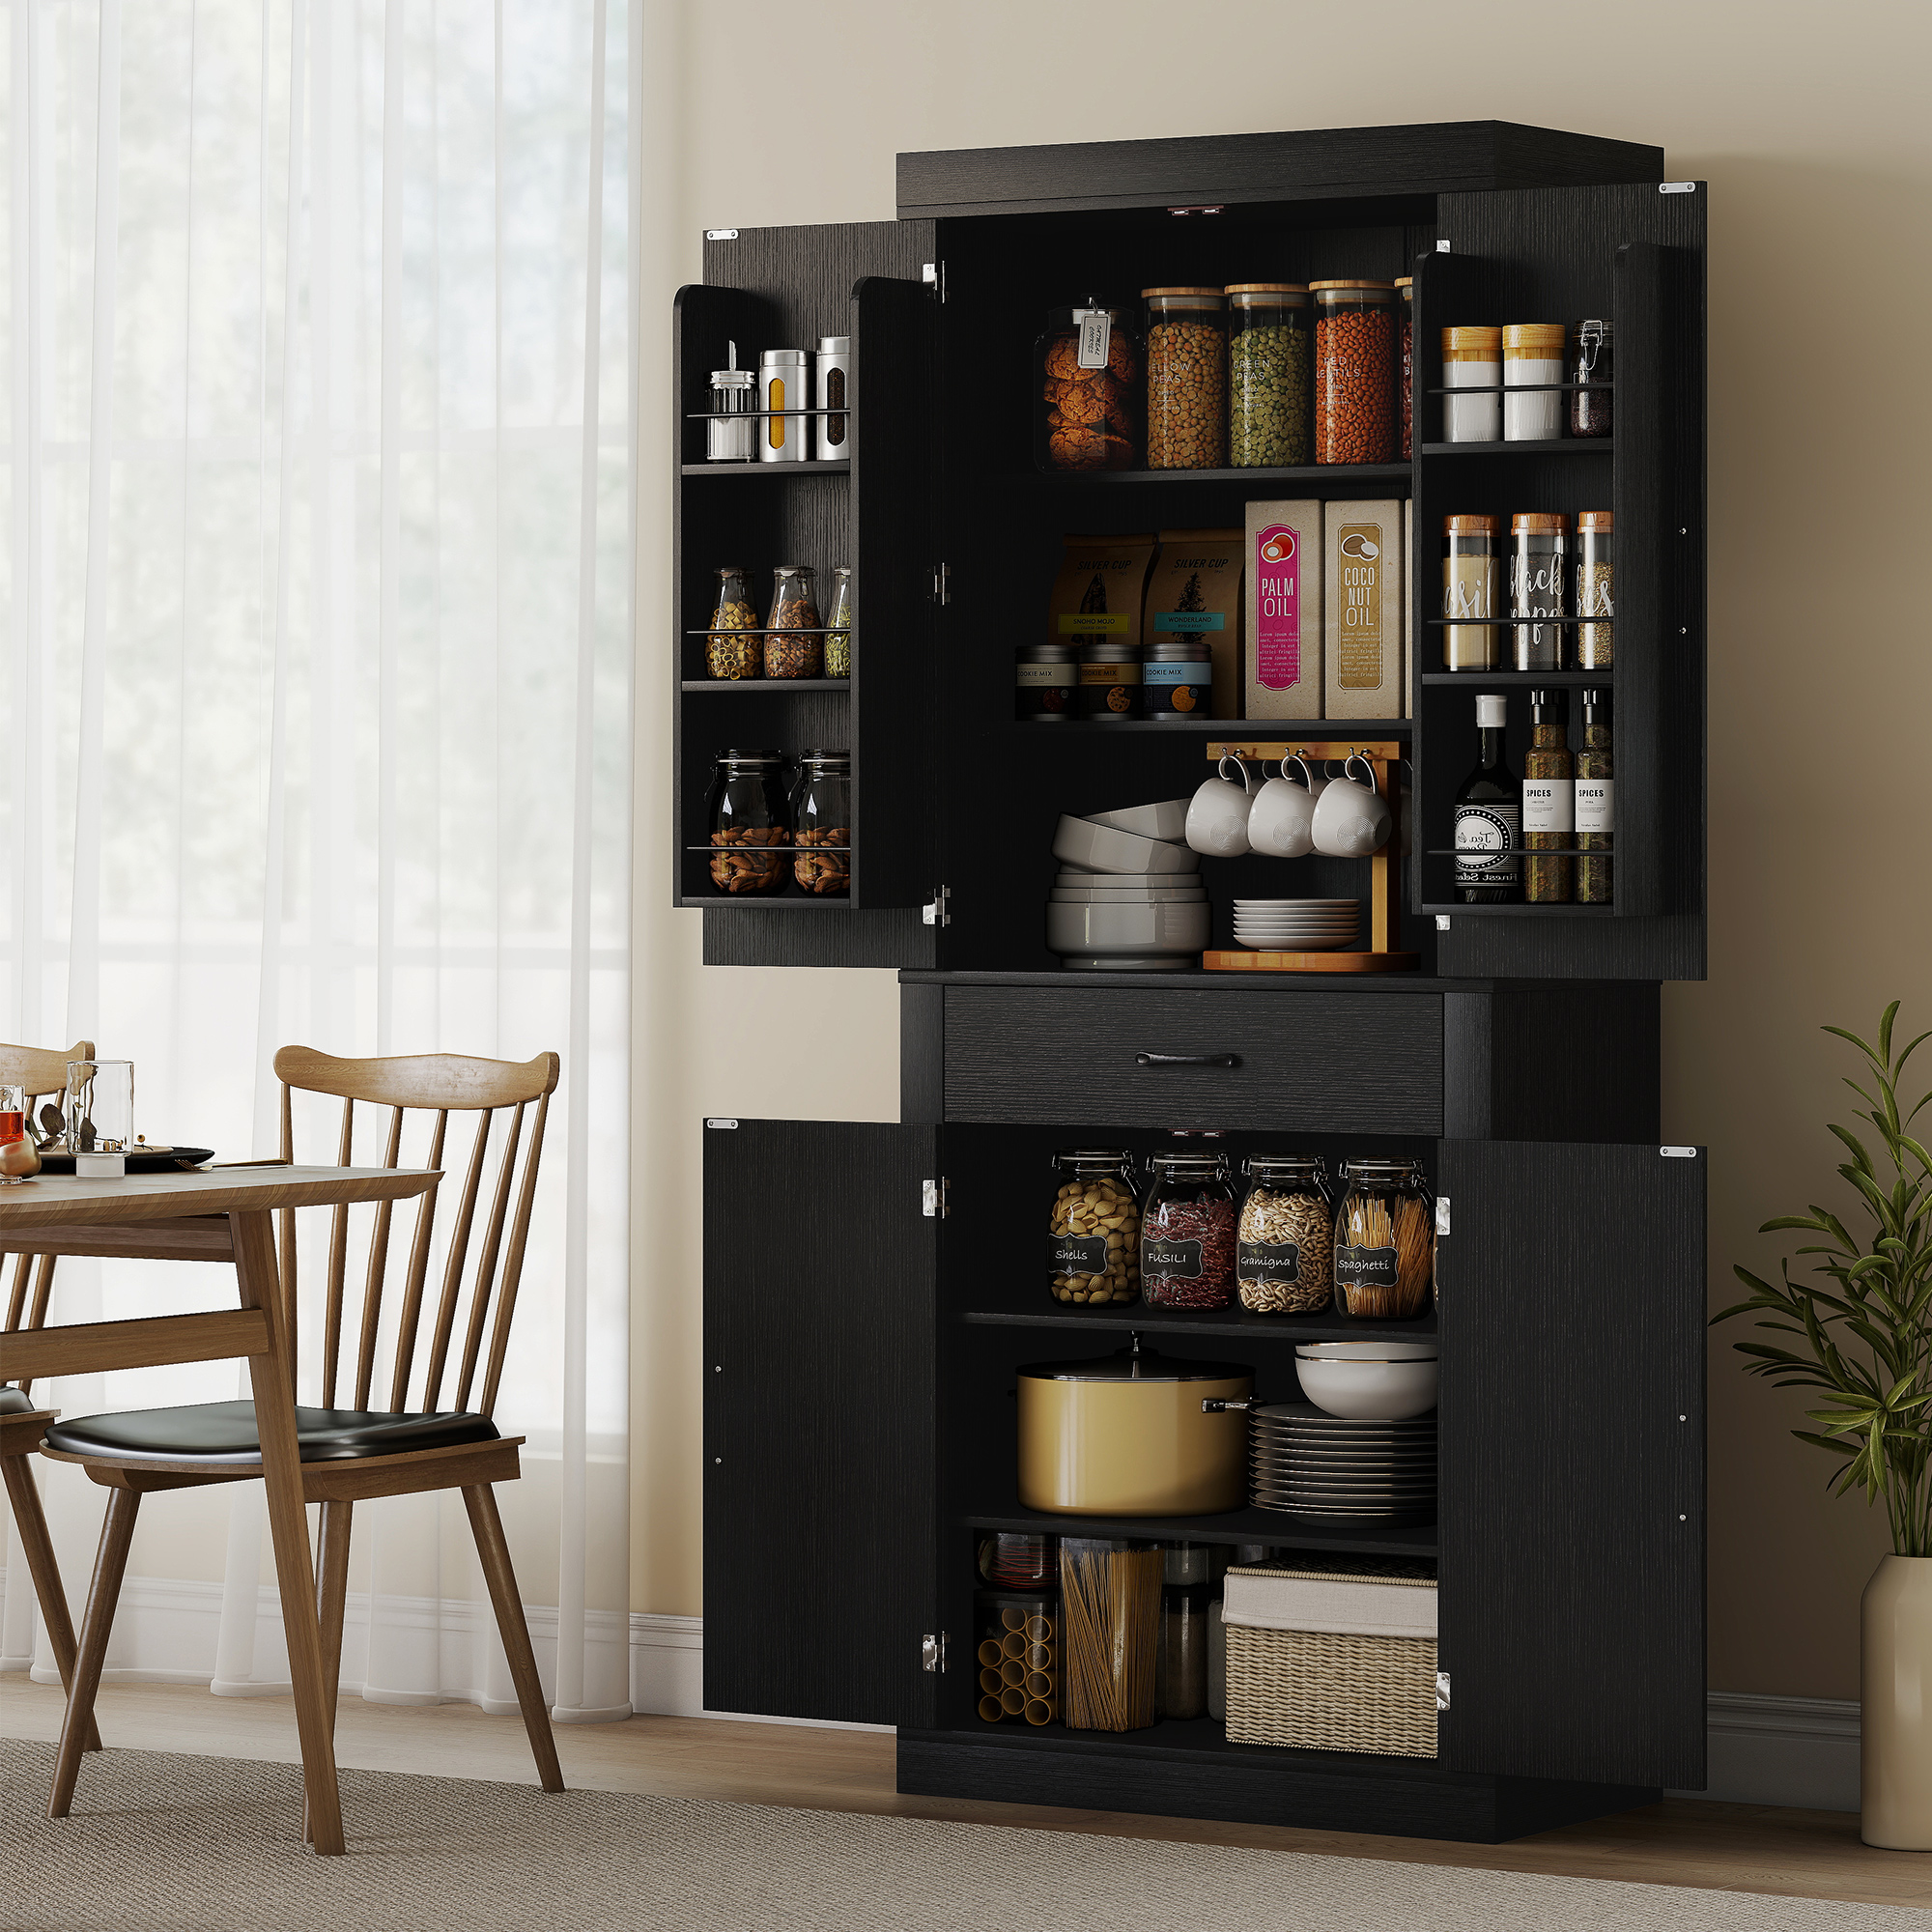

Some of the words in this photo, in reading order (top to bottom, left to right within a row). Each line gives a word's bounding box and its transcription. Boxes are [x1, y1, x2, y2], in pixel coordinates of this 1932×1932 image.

[1233, 359, 1270, 369] GREEN
[1152, 375, 1181, 384] PEAS
[1236, 371, 1265, 381] PEAS
[1316, 368, 1360, 379] LETILS
[1077, 560, 1110, 570] SILVER
[1112, 559, 1132, 569] CUP
[1174, 558, 1207, 568] SILVER
[1208, 558, 1229, 568] CUP
[1345, 566, 1375, 586] COCO
[1262, 578, 1294, 597] PALM
[1348, 587, 1373, 607] NUT
[1264, 598, 1293, 617] OIL
[1346, 607, 1375, 627] OIL
[1055, 1249, 1088, 1261] Shells
[1240, 1255, 1291, 1269] Gramigna
[1338, 1259, 1390, 1273] Spaghetti
